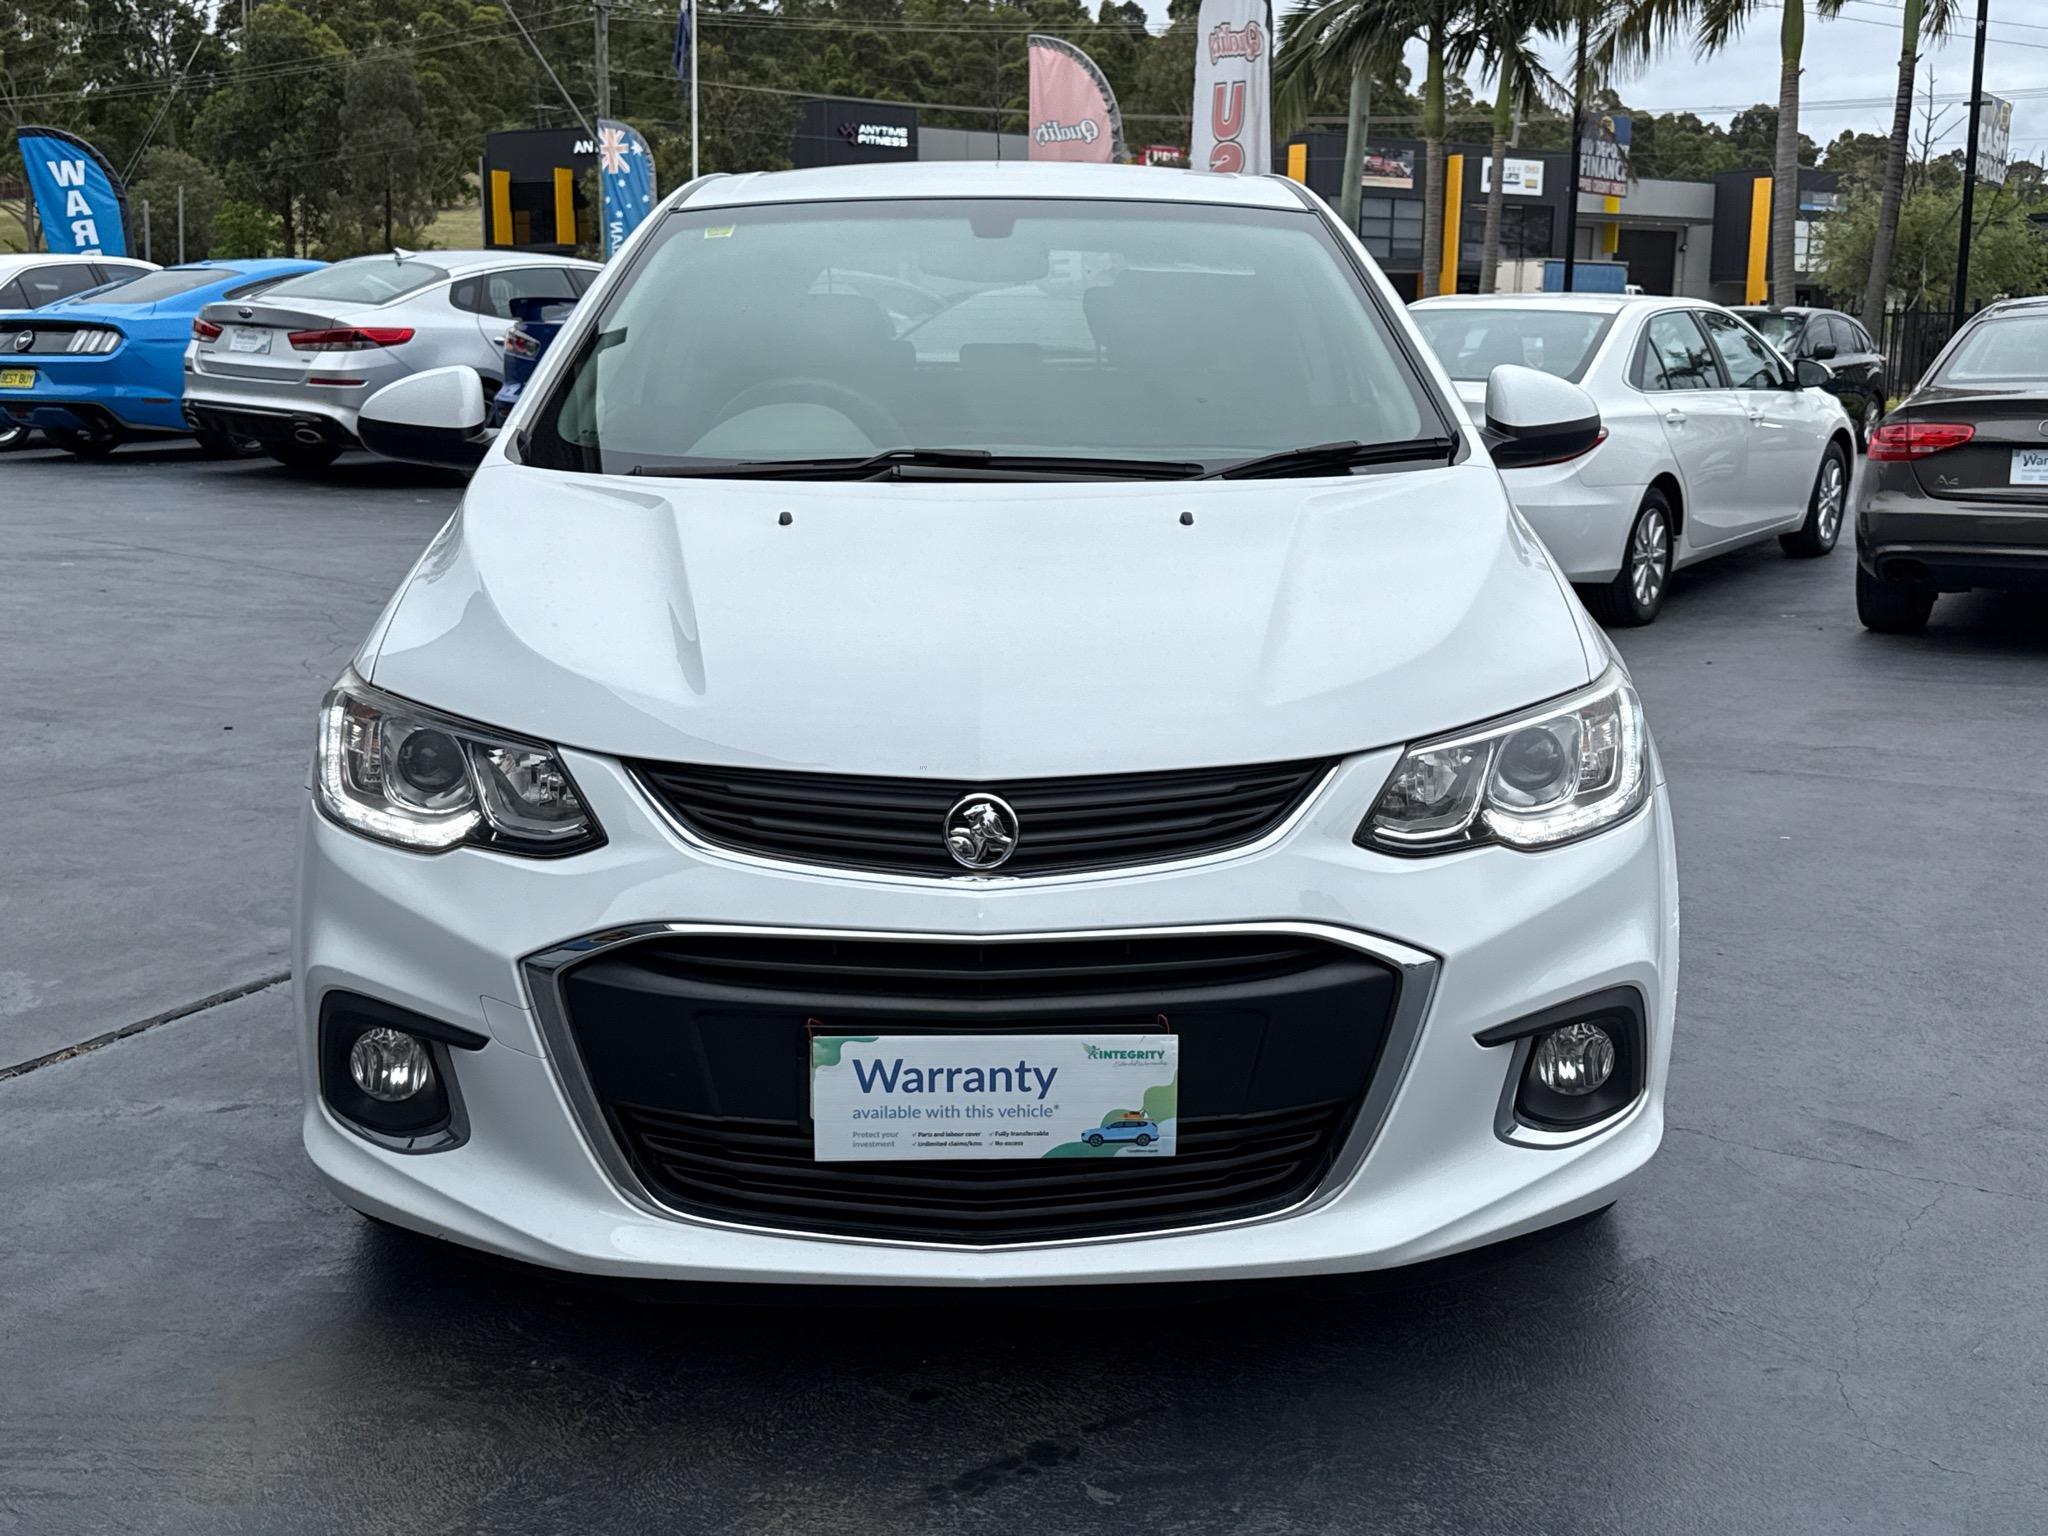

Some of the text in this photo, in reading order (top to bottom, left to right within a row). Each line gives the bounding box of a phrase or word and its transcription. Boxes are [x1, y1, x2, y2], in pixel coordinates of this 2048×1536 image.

[859, 124, 908, 137] ANYTIME
[857, 135, 908, 147] FITNESS
[19, 373, 33, 384] BUY
[1100, 1050, 1165, 1060] INTEGRITY
[852, 1058, 1058, 1100] Warranty
[852, 1105, 921, 1119] available
[925, 1105, 961, 1119] with
[965, 1104, 994, 1119] this
[852, 1140, 895, 1148] investment
